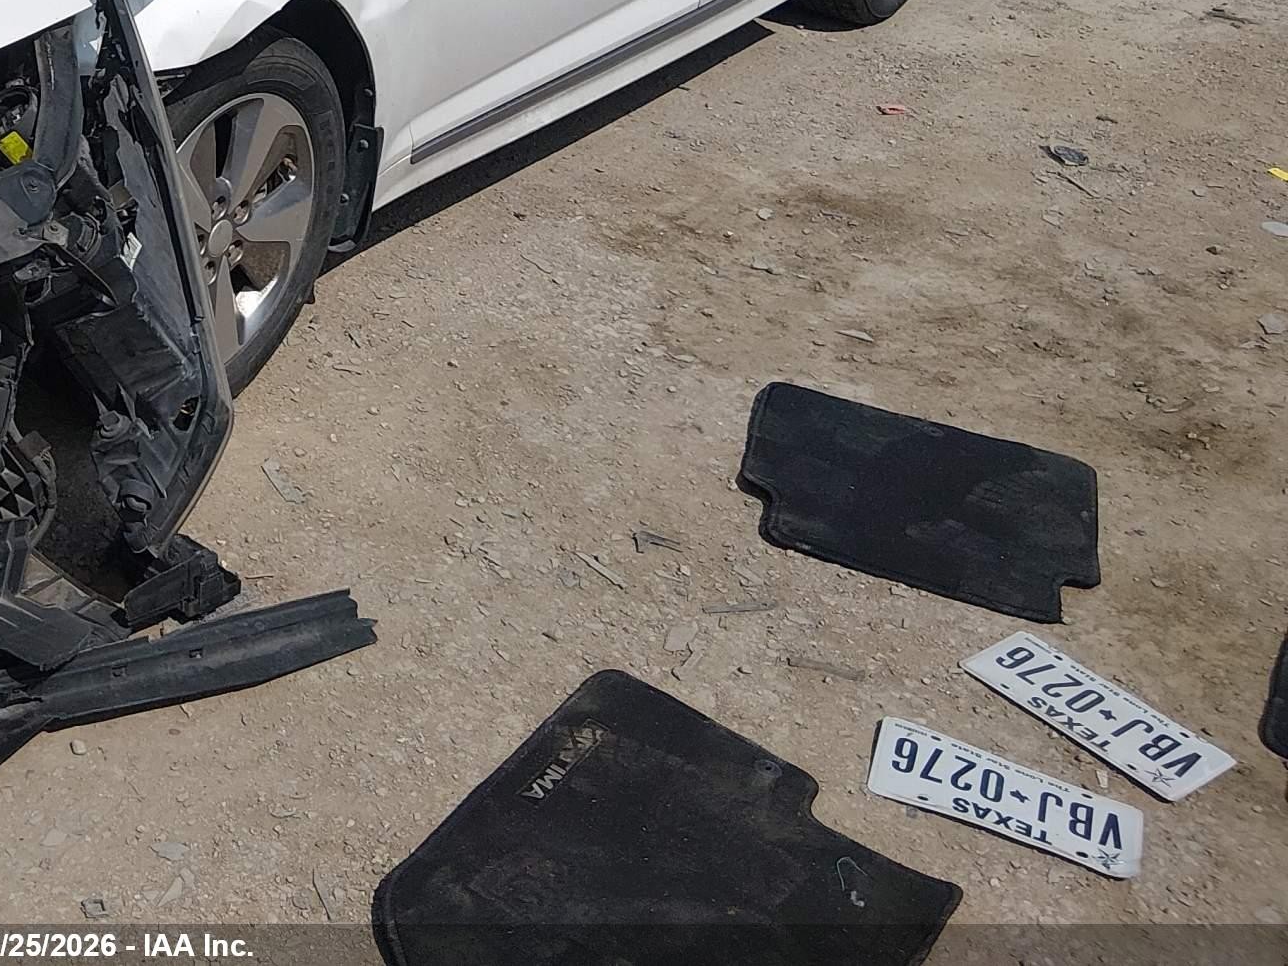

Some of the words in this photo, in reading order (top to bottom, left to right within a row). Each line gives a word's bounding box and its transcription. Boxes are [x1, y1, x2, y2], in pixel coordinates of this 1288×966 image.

[1070, 665, 1096, 682] State
[1099, 683, 1120, 697] Star
[1123, 697, 1148, 713] Lone
[1027, 696, 1111, 752] TEXAS
[1151, 714, 1169, 727] The
[951, 743, 982, 758] State
[986, 757, 1010, 770] Star
[1015, 769, 1044, 783] Lone
[1048, 782, 1070, 792] The
[952, 797, 1053, 845] TEXAS
